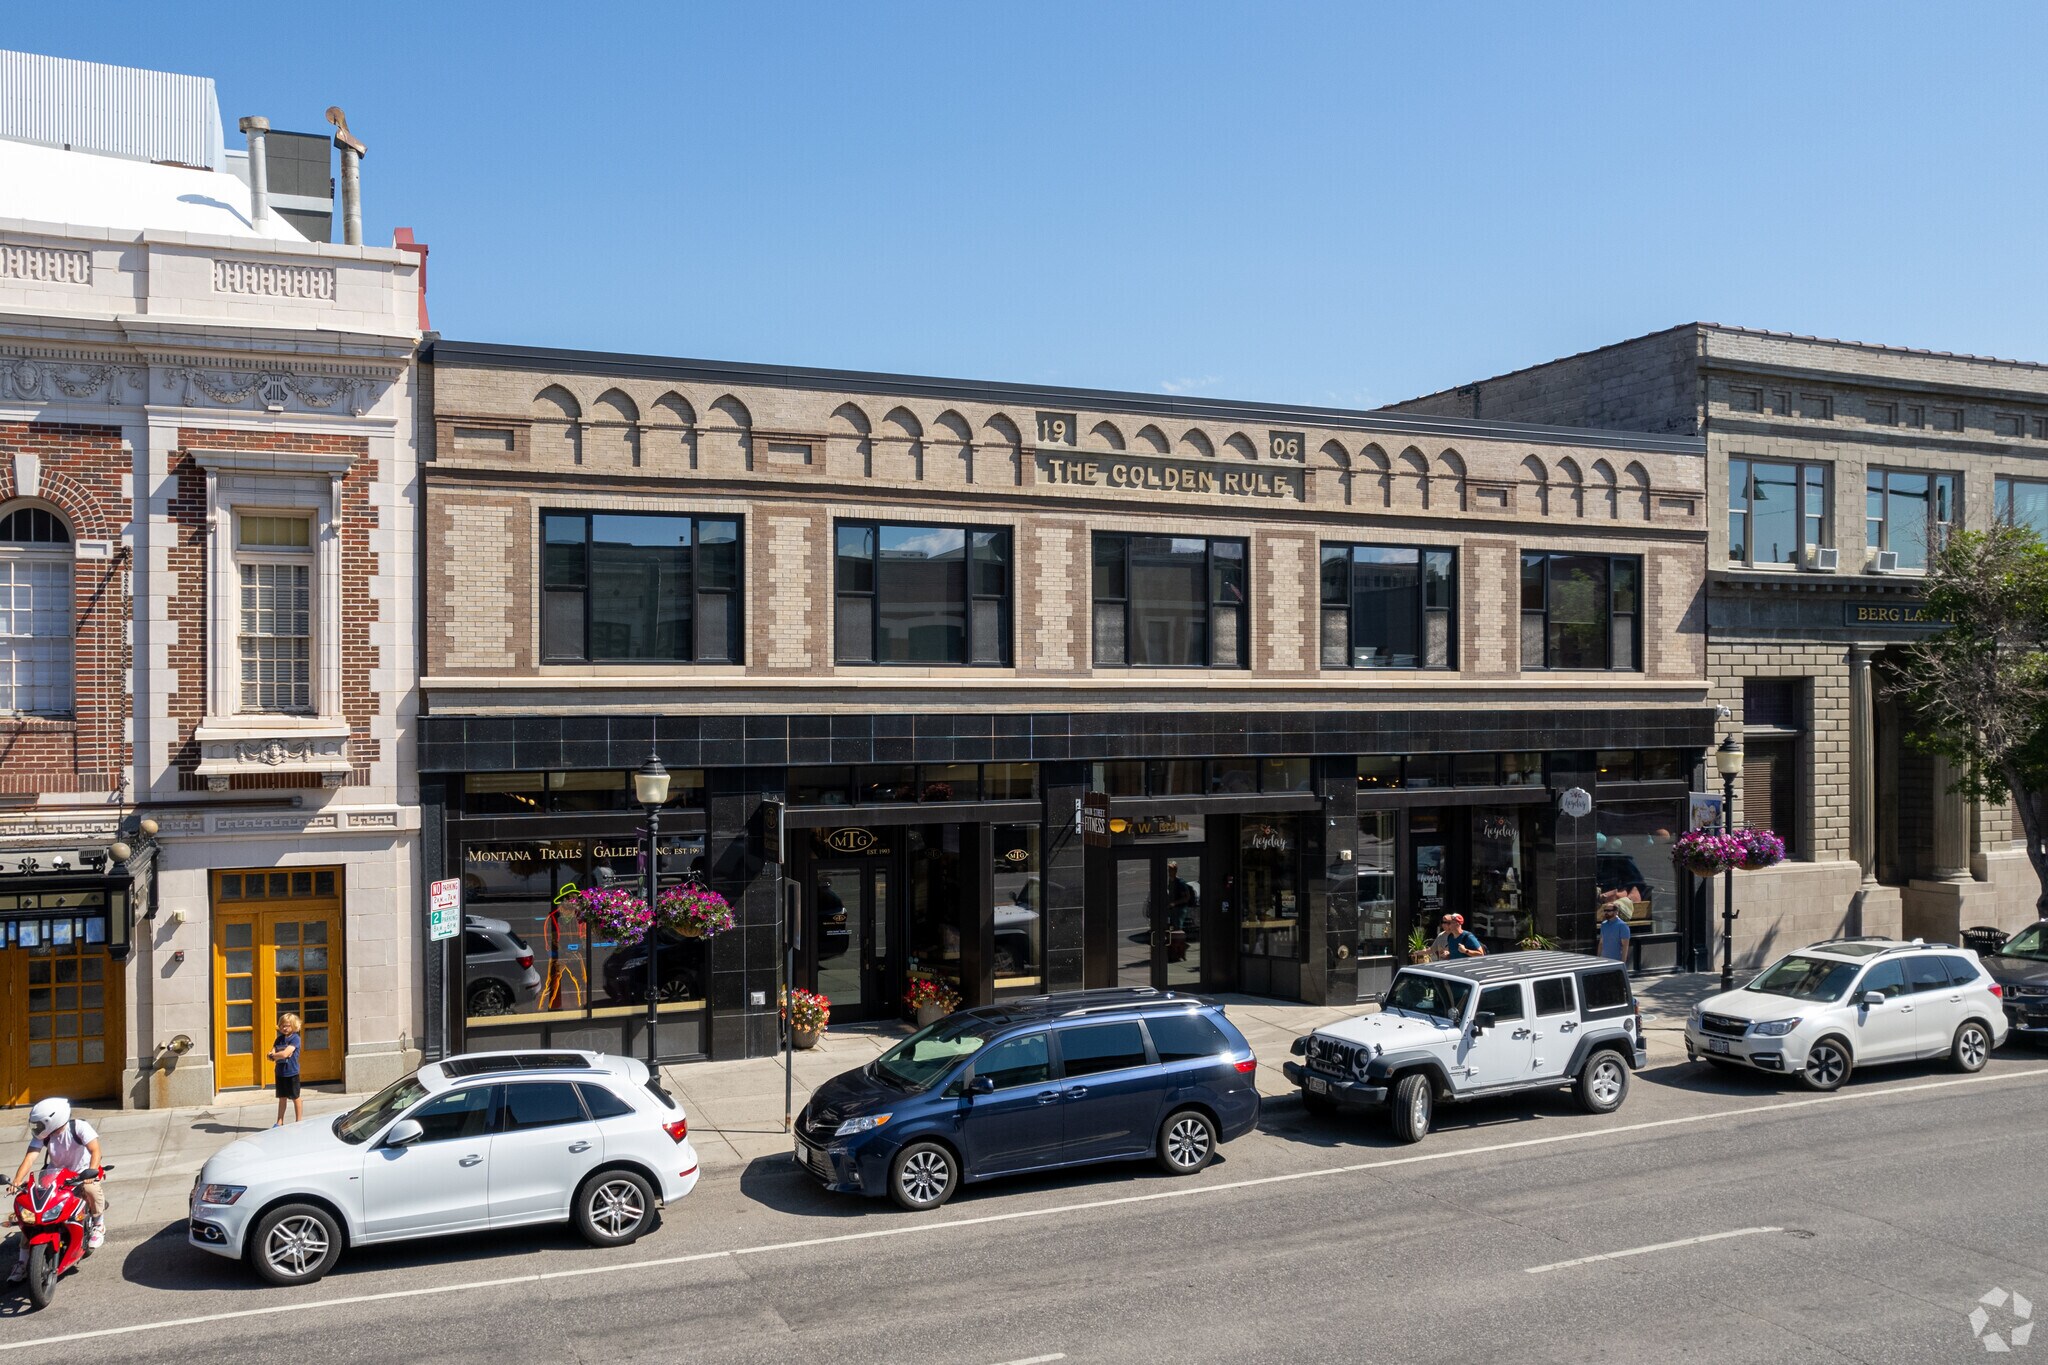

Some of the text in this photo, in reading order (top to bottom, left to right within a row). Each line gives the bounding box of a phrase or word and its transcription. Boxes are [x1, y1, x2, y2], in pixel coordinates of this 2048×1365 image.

[1042, 419, 1067, 440] 19
[1273, 438, 1298, 457] 06
[1049, 459, 1289, 494] THE GOLDEN RULE
[1857, 607, 1900, 621] BERG
[1084, 816, 1106, 834] FITNESS
[1484, 824, 1520, 840] heyday
[835, 831, 867, 848] MTG
[1252, 833, 1288, 851] heyday
[468, 850, 532, 862] MONTANA
[539, 848, 583, 860] TRAILS
[593, 846, 639, 858] GALLER
[655, 847, 672, 856] NC.
[433, 912, 439, 924] 2
